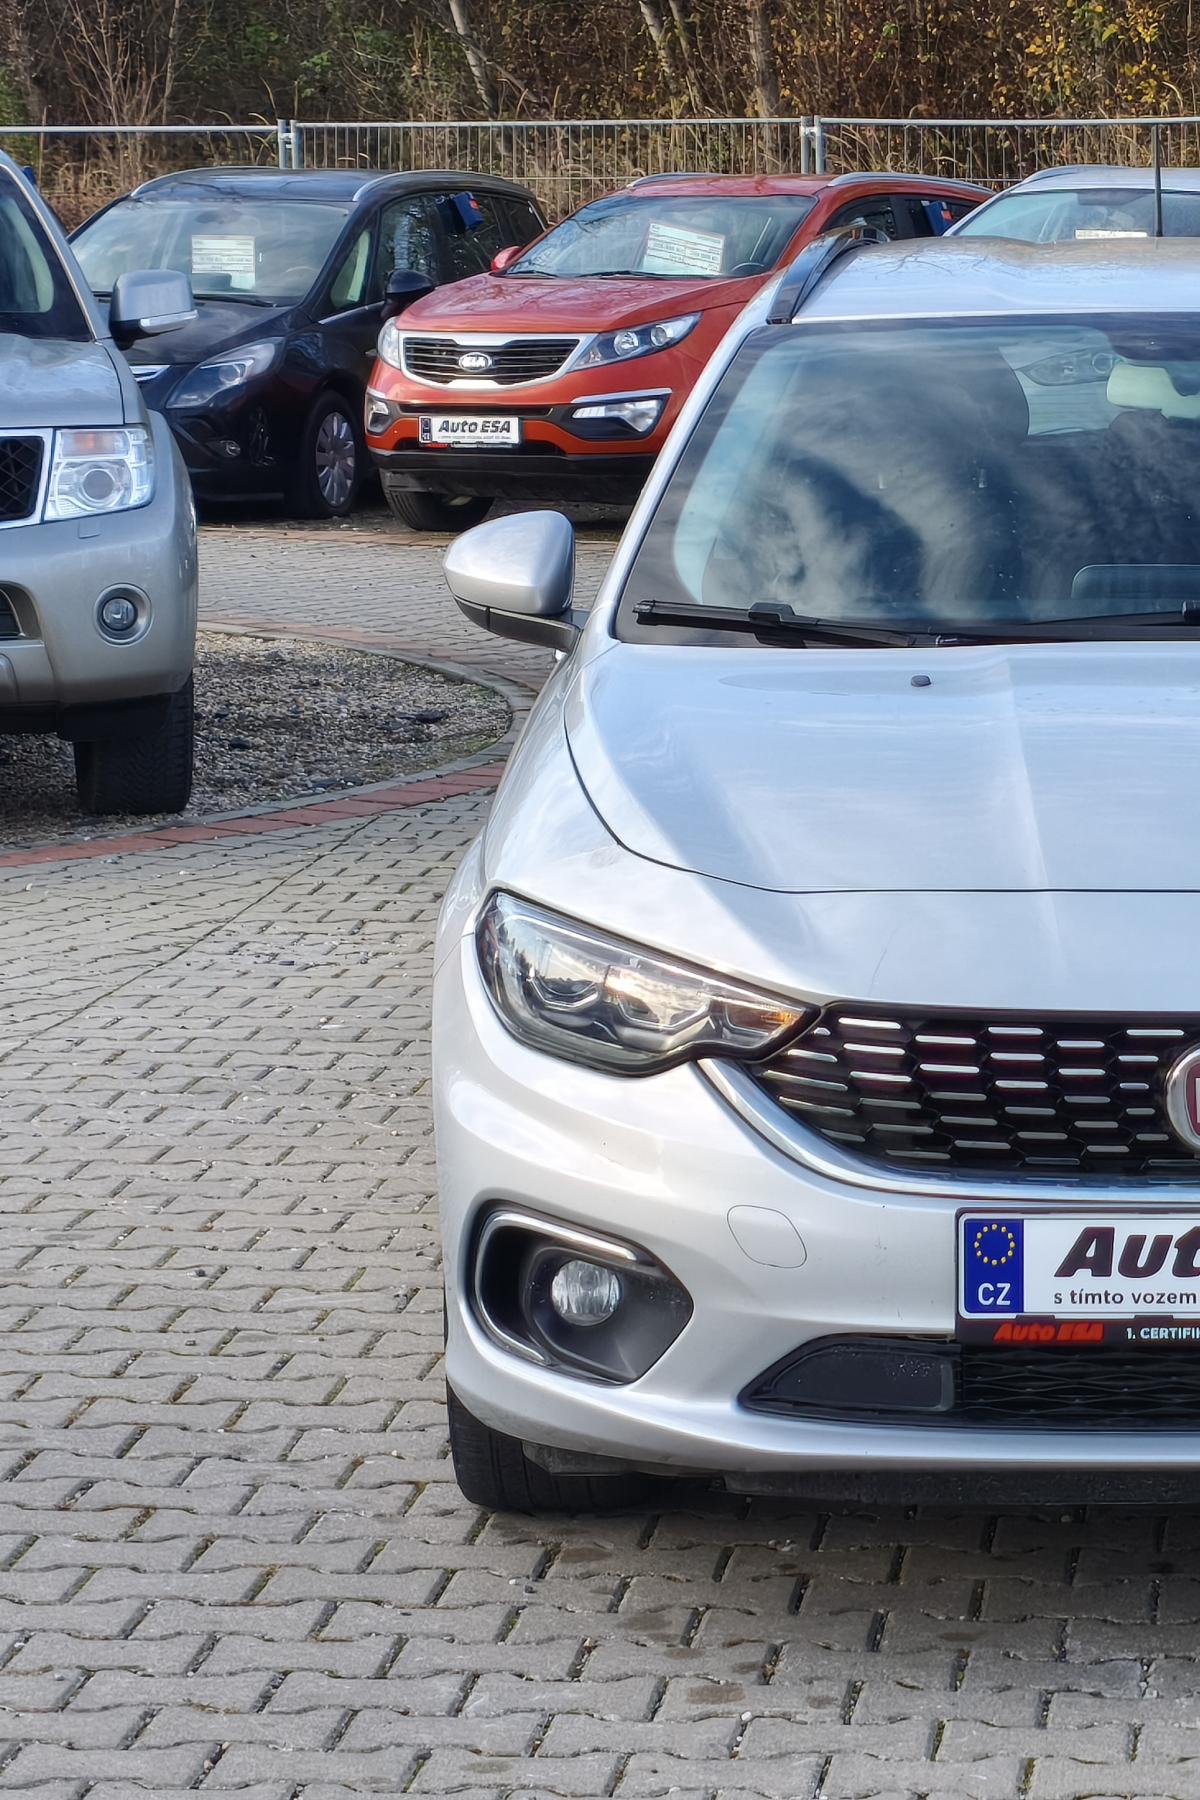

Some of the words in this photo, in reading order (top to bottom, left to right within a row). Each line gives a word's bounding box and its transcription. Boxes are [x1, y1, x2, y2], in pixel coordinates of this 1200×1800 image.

[439, 420, 478, 433] Auto
[480, 420, 511, 433] ESA
[978, 1282, 1011, 1306] CZ
[1053, 1292, 1063, 1304] s
[1069, 1288, 1124, 1305] tímto
[1131, 1291, 1197, 1305] vozem
[994, 1323, 1055, 1341] Auto
[1126, 1327, 1136, 1340] 1.
